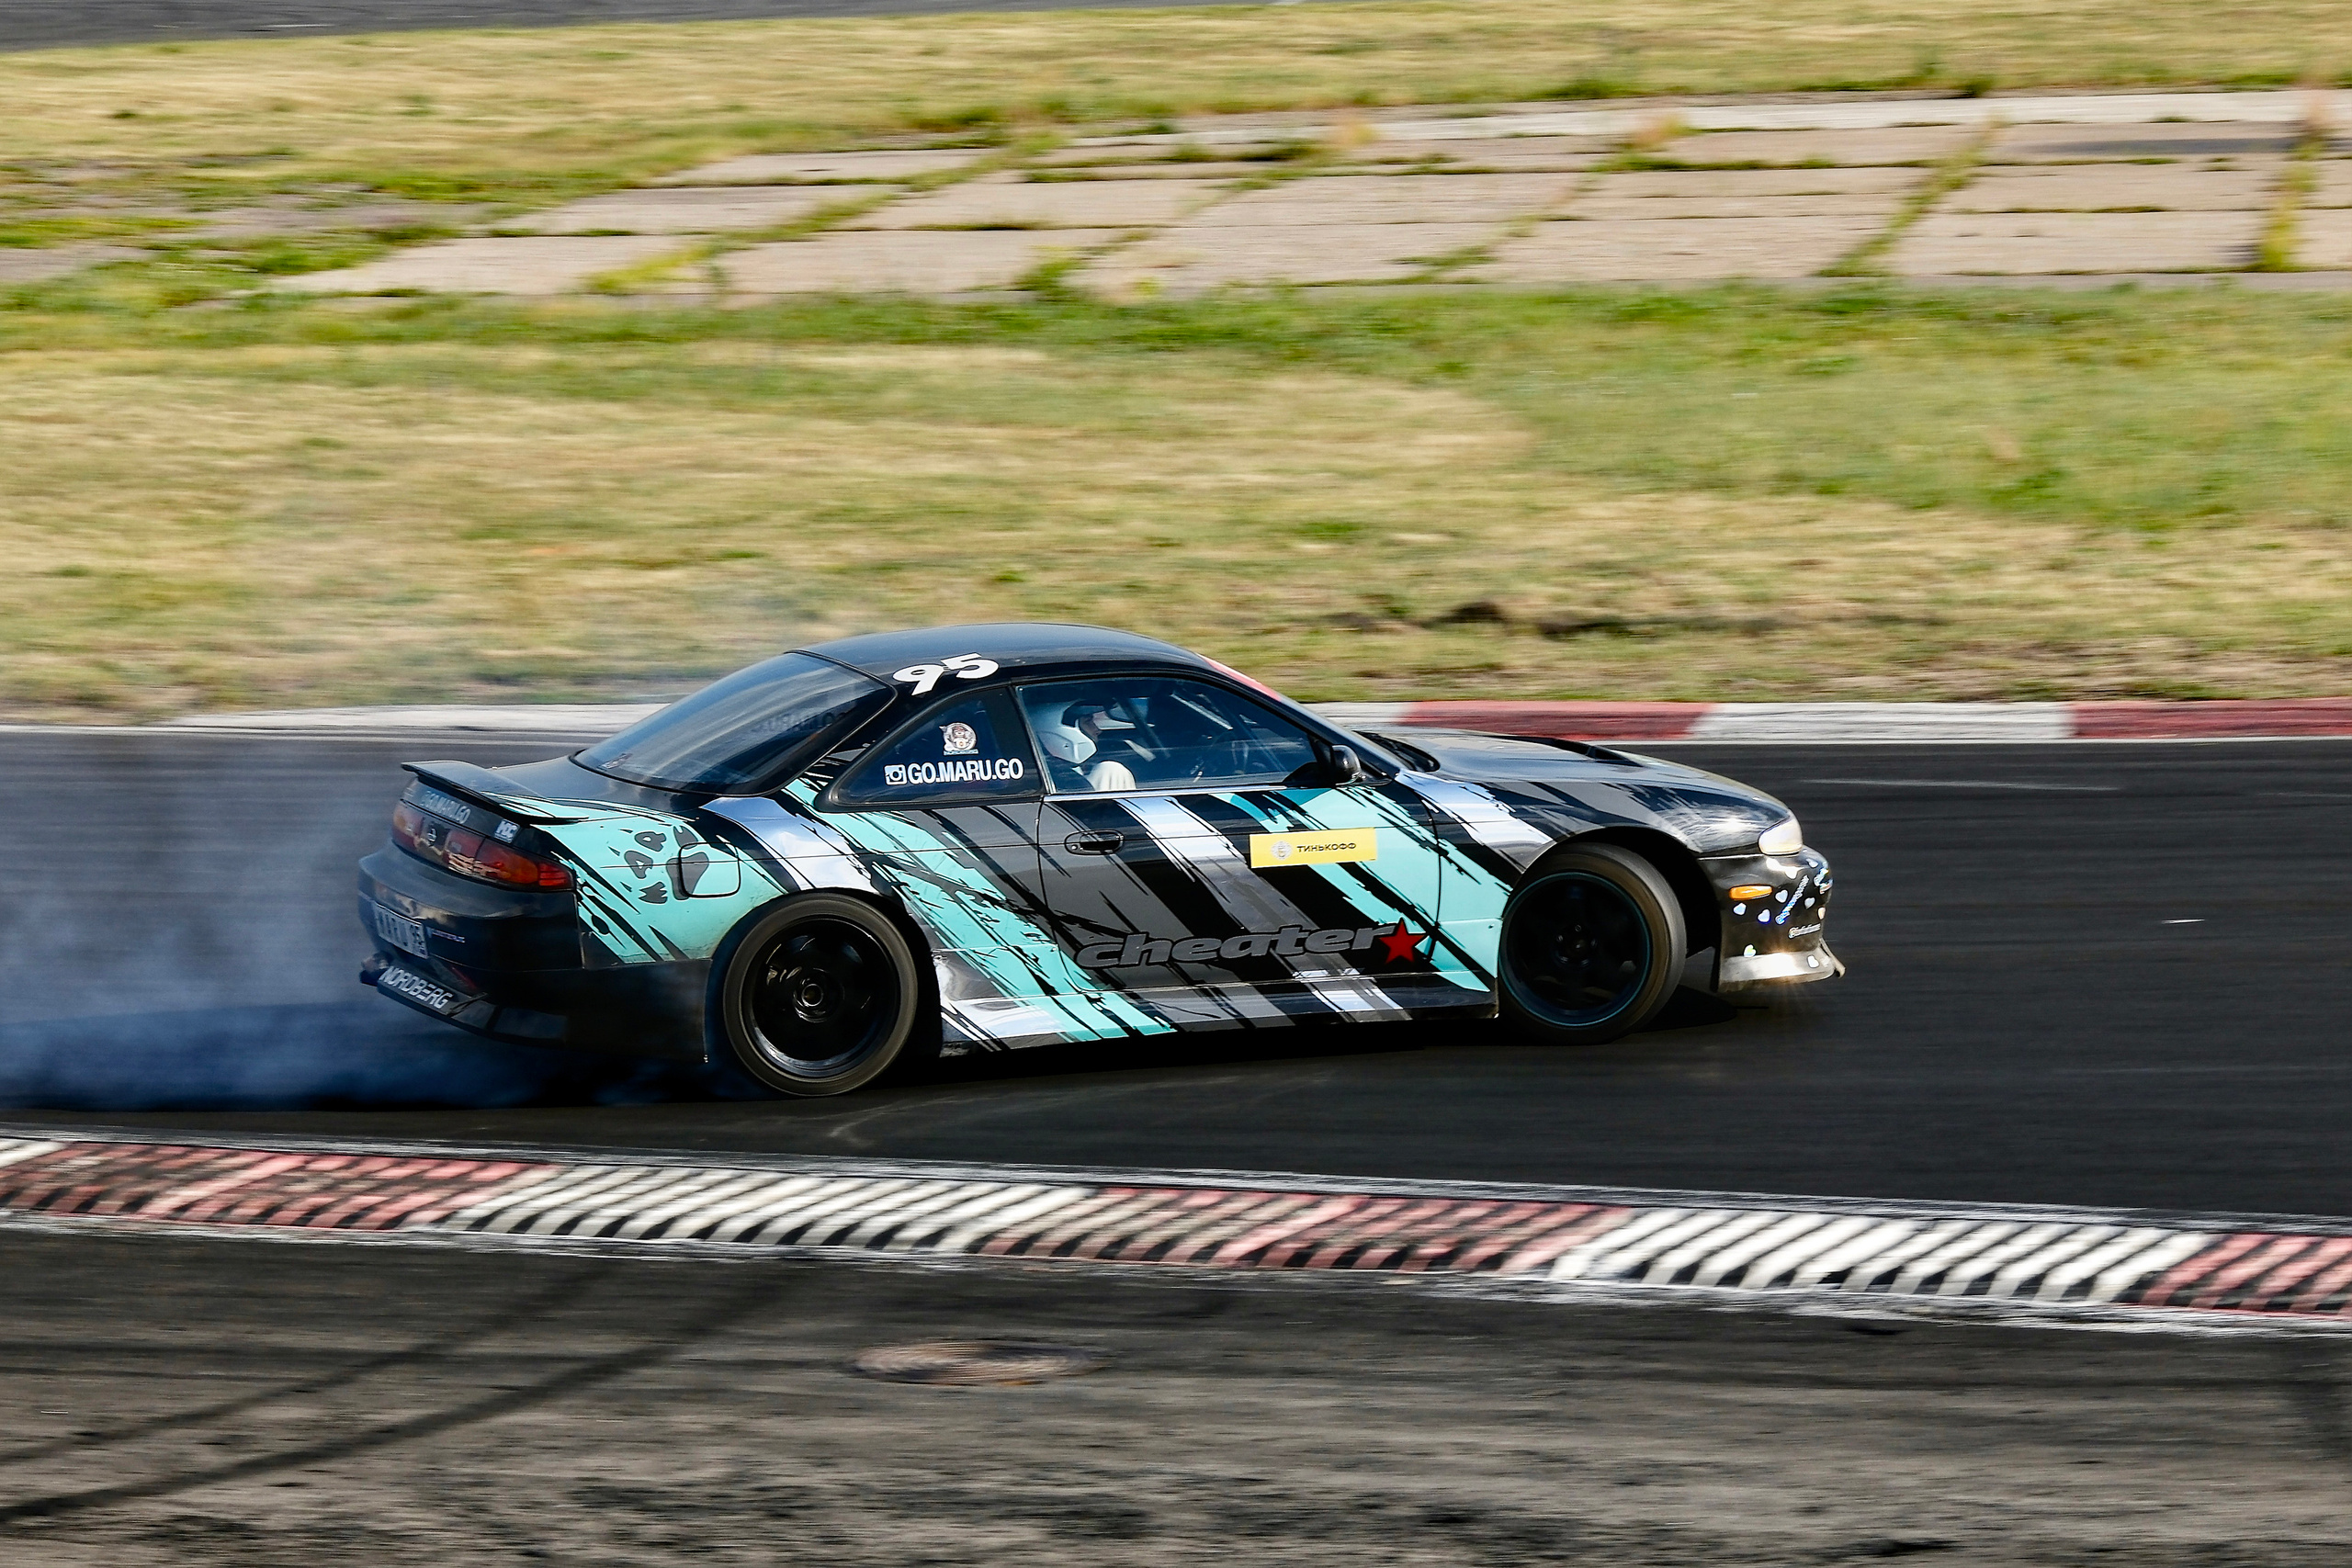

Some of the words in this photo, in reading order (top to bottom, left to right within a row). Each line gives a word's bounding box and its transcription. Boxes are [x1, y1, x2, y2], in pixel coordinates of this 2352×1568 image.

[892, 651, 1000, 695] 95
[908, 758, 1024, 784] GO.MARU.GO
[1297, 842, 1357, 852] ТИНЬКОФФ
[1076, 922, 1396, 967] cheater
[379, 966, 453, 1009] NORDBERG
